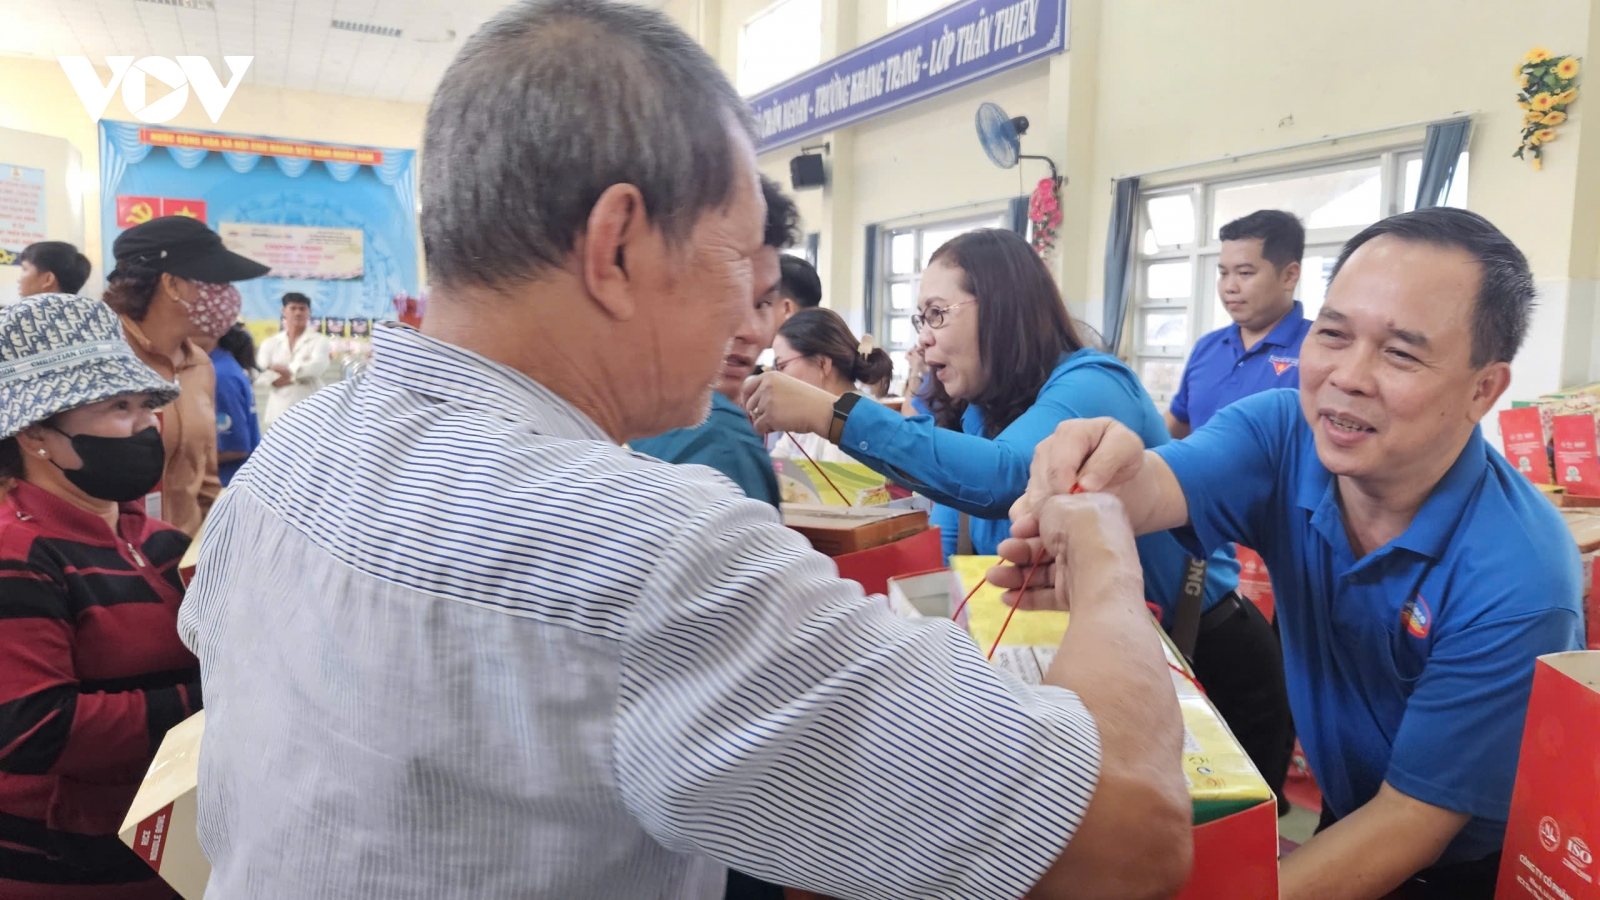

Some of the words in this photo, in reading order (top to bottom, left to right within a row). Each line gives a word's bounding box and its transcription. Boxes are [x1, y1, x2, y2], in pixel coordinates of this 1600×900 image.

[929, 24, 956, 77] LỚP
[956, 7, 995, 67] THÂN
[994, 0, 1040, 53] THIỆN
[0, 367, 15, 376] IOR
[31, 350, 77, 367] CHRISTIAN
[79, 345, 98, 356] DIOR
[1567, 838, 1593, 865] ISO
